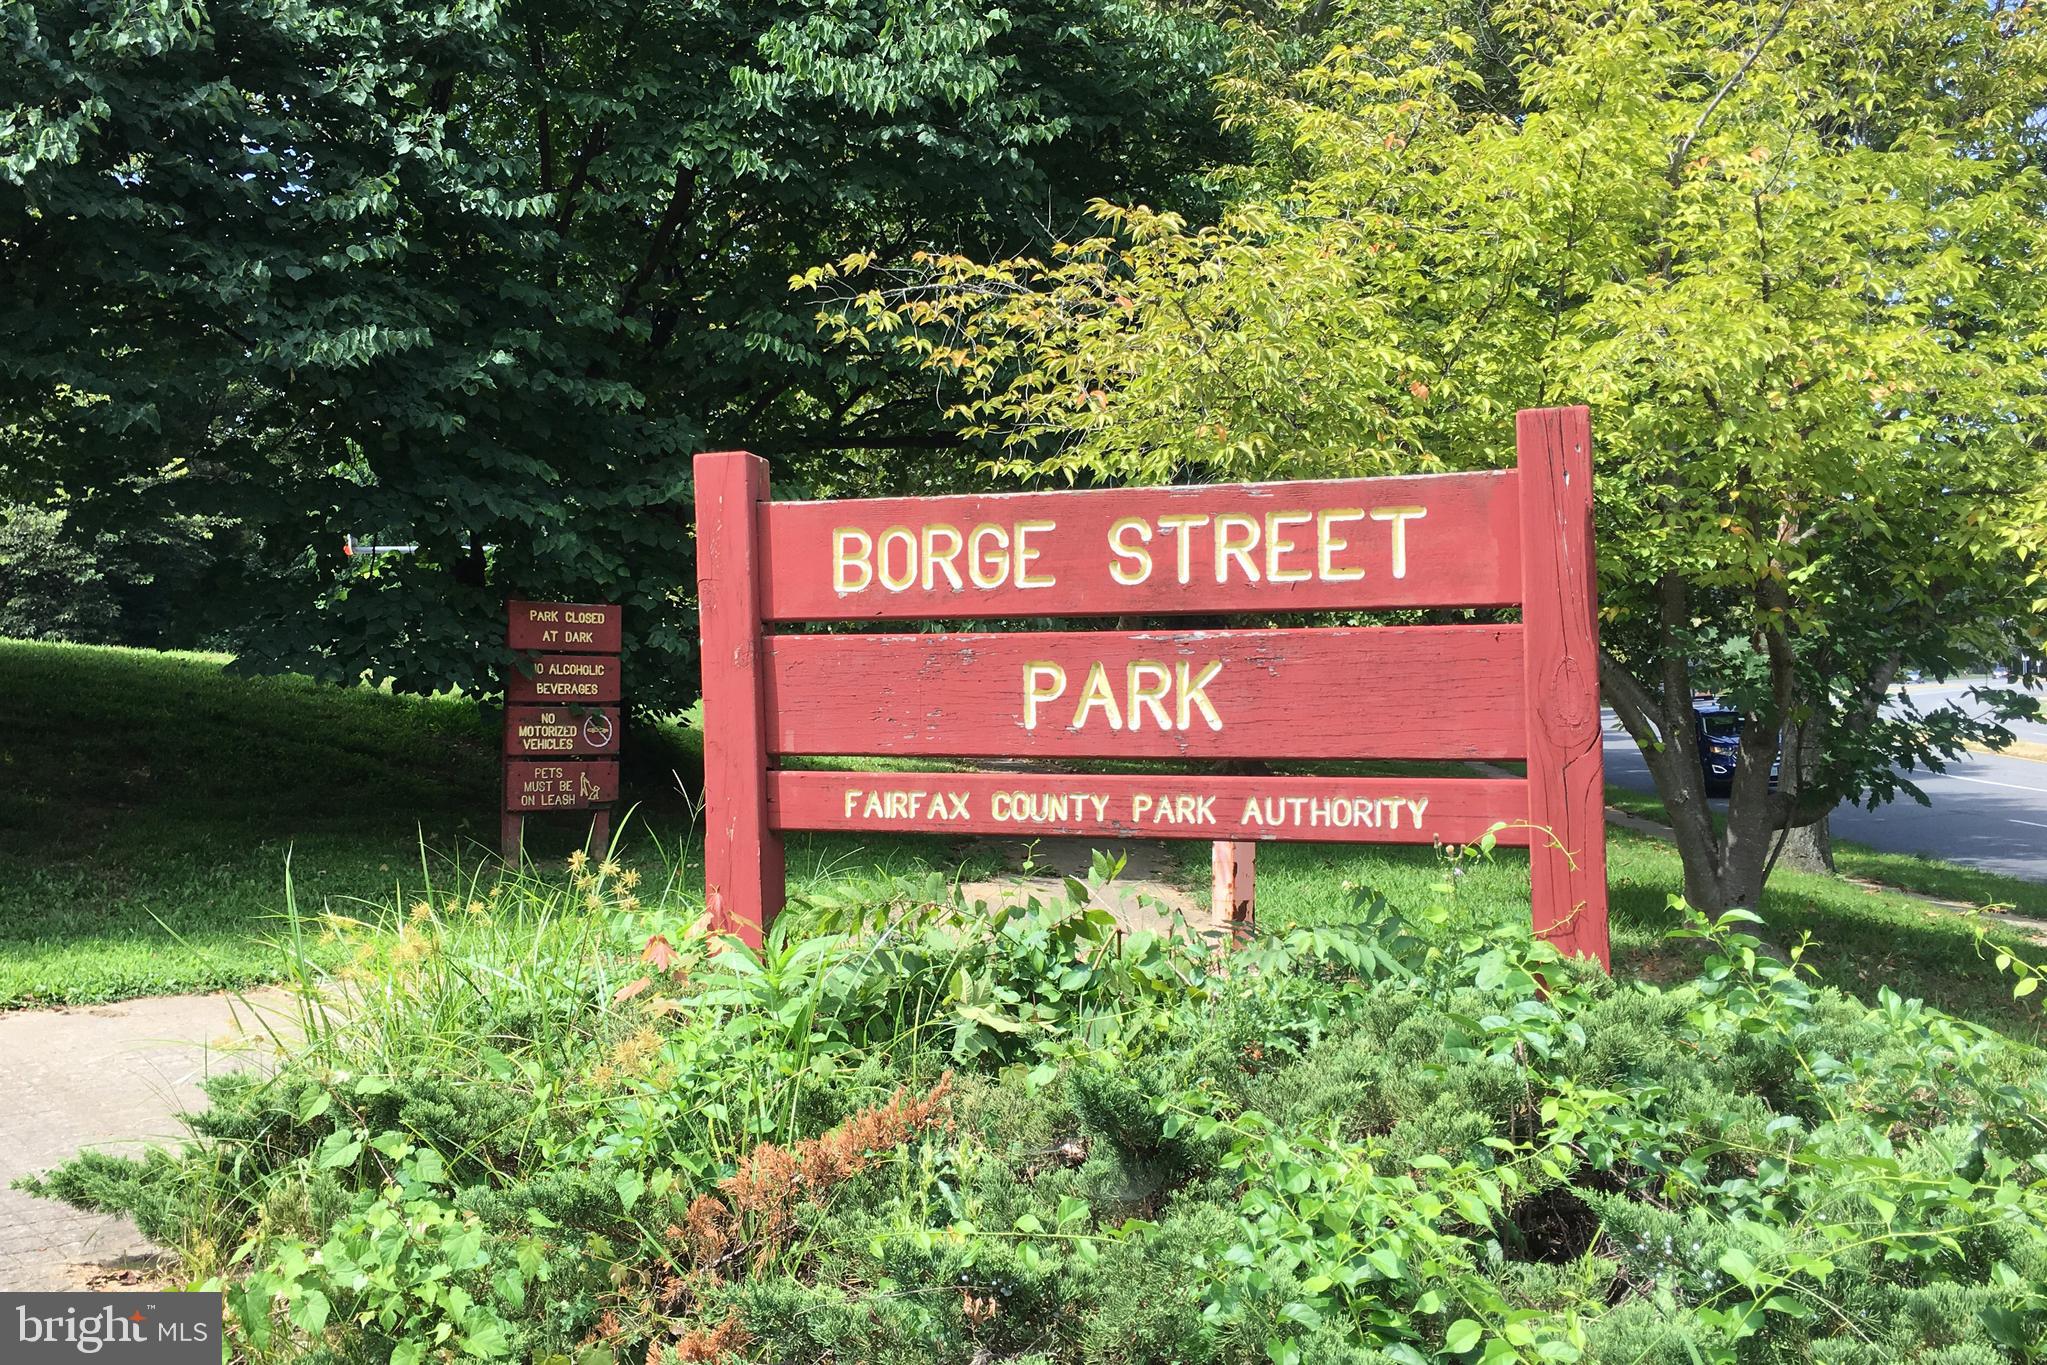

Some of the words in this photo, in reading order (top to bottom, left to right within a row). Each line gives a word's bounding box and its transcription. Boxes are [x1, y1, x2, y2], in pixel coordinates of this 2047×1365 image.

[832, 520, 1056, 593] BORGE
[1107, 506, 1427, 587] STREET
[530, 610, 559, 622] PARK
[565, 611, 605, 624] CLOSED
[542, 630, 559, 642] AT
[565, 632, 593, 643] DARK
[549, 664, 605, 676] ALCOHOLIC
[536, 683, 598, 695] BEVERAGES
[1022, 660, 1223, 732] PARK
[541, 713, 556, 724] NO
[518, 726, 577, 737] MOTORIZED
[523, 739, 574, 750] VEHICLES
[534, 767, 563, 779] PETS
[524, 781, 553, 792] MUST
[559, 780, 573, 792] BE
[521, 795, 536, 806] ON
[541, 794, 576, 806] LEASH
[844, 789, 970, 820] FAIRFAX
[991, 789, 1110, 823] COUNTY
[1131, 794, 1217, 825] PARK
[1241, 795, 1429, 829] AUTHORITY
